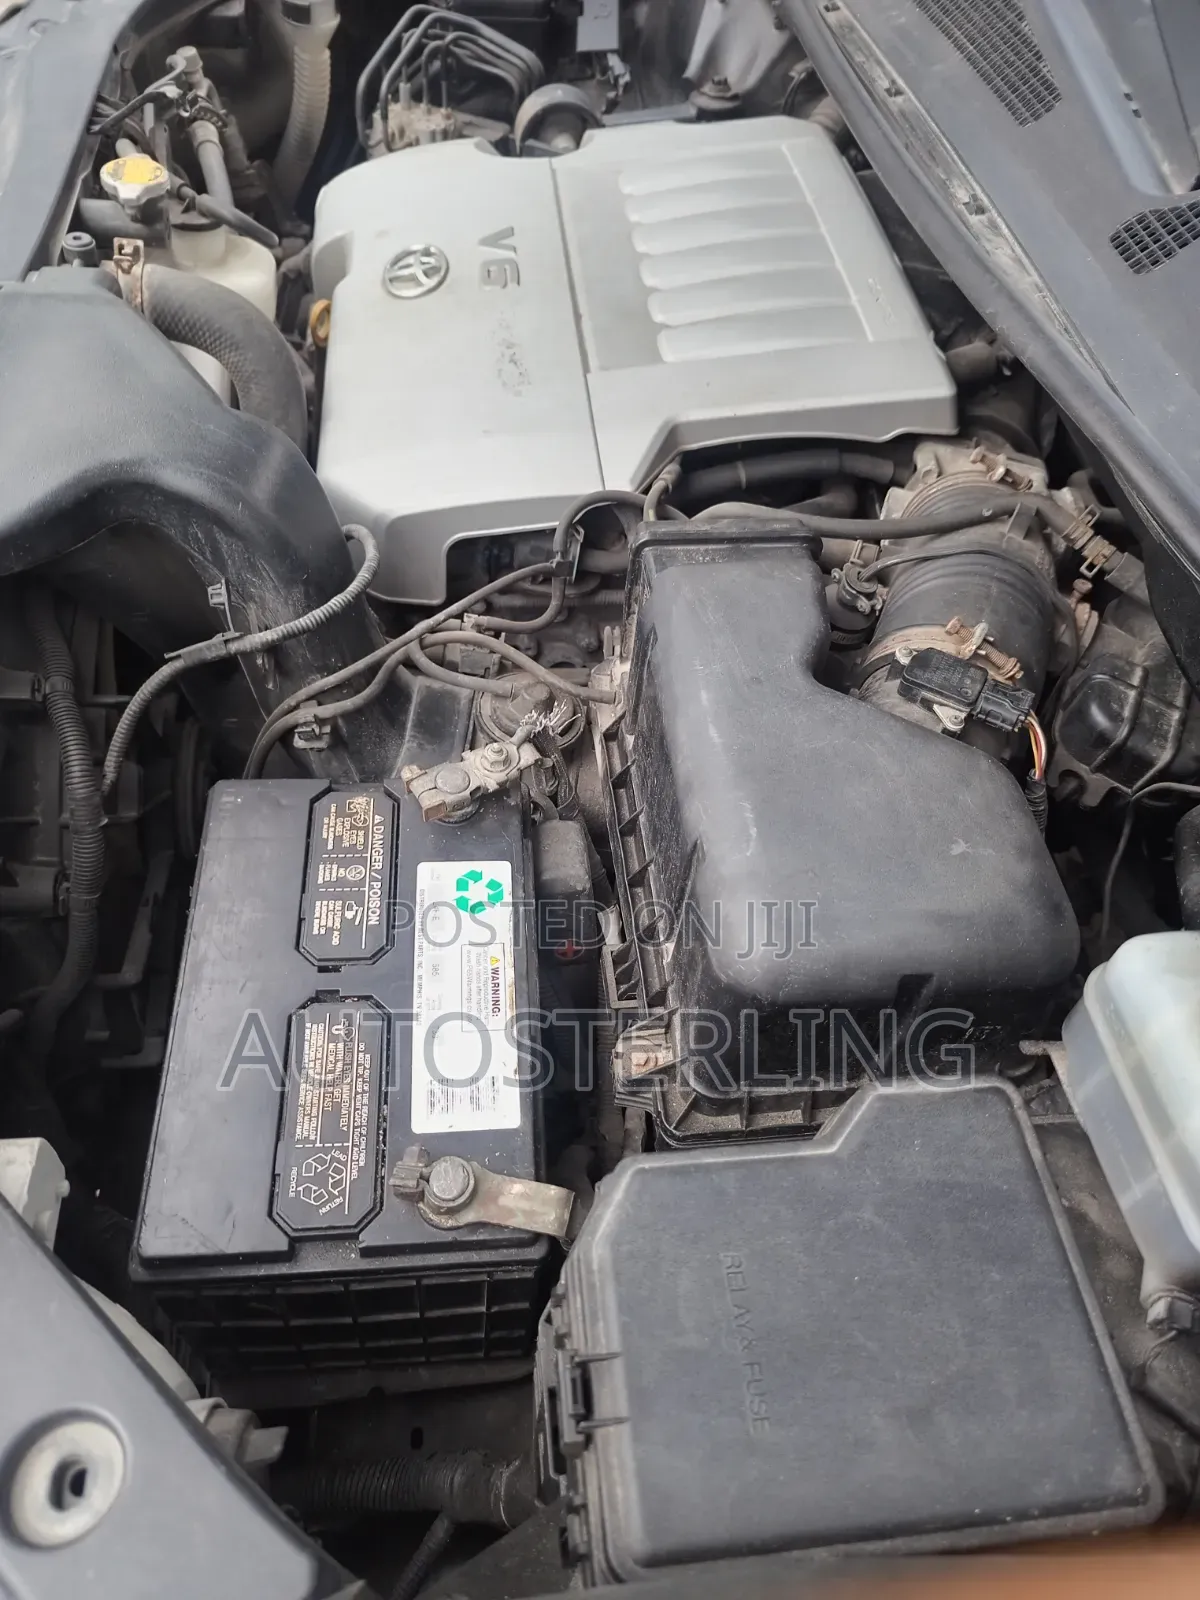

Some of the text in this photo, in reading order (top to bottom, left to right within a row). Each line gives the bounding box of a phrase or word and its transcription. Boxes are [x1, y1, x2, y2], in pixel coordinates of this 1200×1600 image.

[478, 226, 521, 290] V6
[342, 818, 351, 847] EXPLOSIVE
[357, 830, 365, 850] SHIELD
[371, 826, 384, 870] DANGER
[338, 868, 345, 877] NO
[368, 882, 381, 925] POISON
[332, 900, 343, 946] SULFURIC ACID
[491, 967, 501, 1017] WARNING:
[336, 1042, 344, 1060] WITH
[344, 1042, 353, 1063] FLUSH
[359, 1043, 365, 1051] DO
[324, 1043, 335, 1111] MEDICAL HELP FAST
[363, 1083, 369, 1091] OF
[298, 1083, 306, 1105] SERVICE
[340, 1085, 350, 1131] IMMEDIATELY
[361, 1127, 367, 1135] OF
[331, 1149, 347, 1162] LEAD
[350, 1161, 359, 1180] LEVEL
[288, 1166, 298, 1198] RECYCLE
[318, 1196, 344, 1216] RETURN
[721, 1252, 771, 1435] RELAY & FUSE
